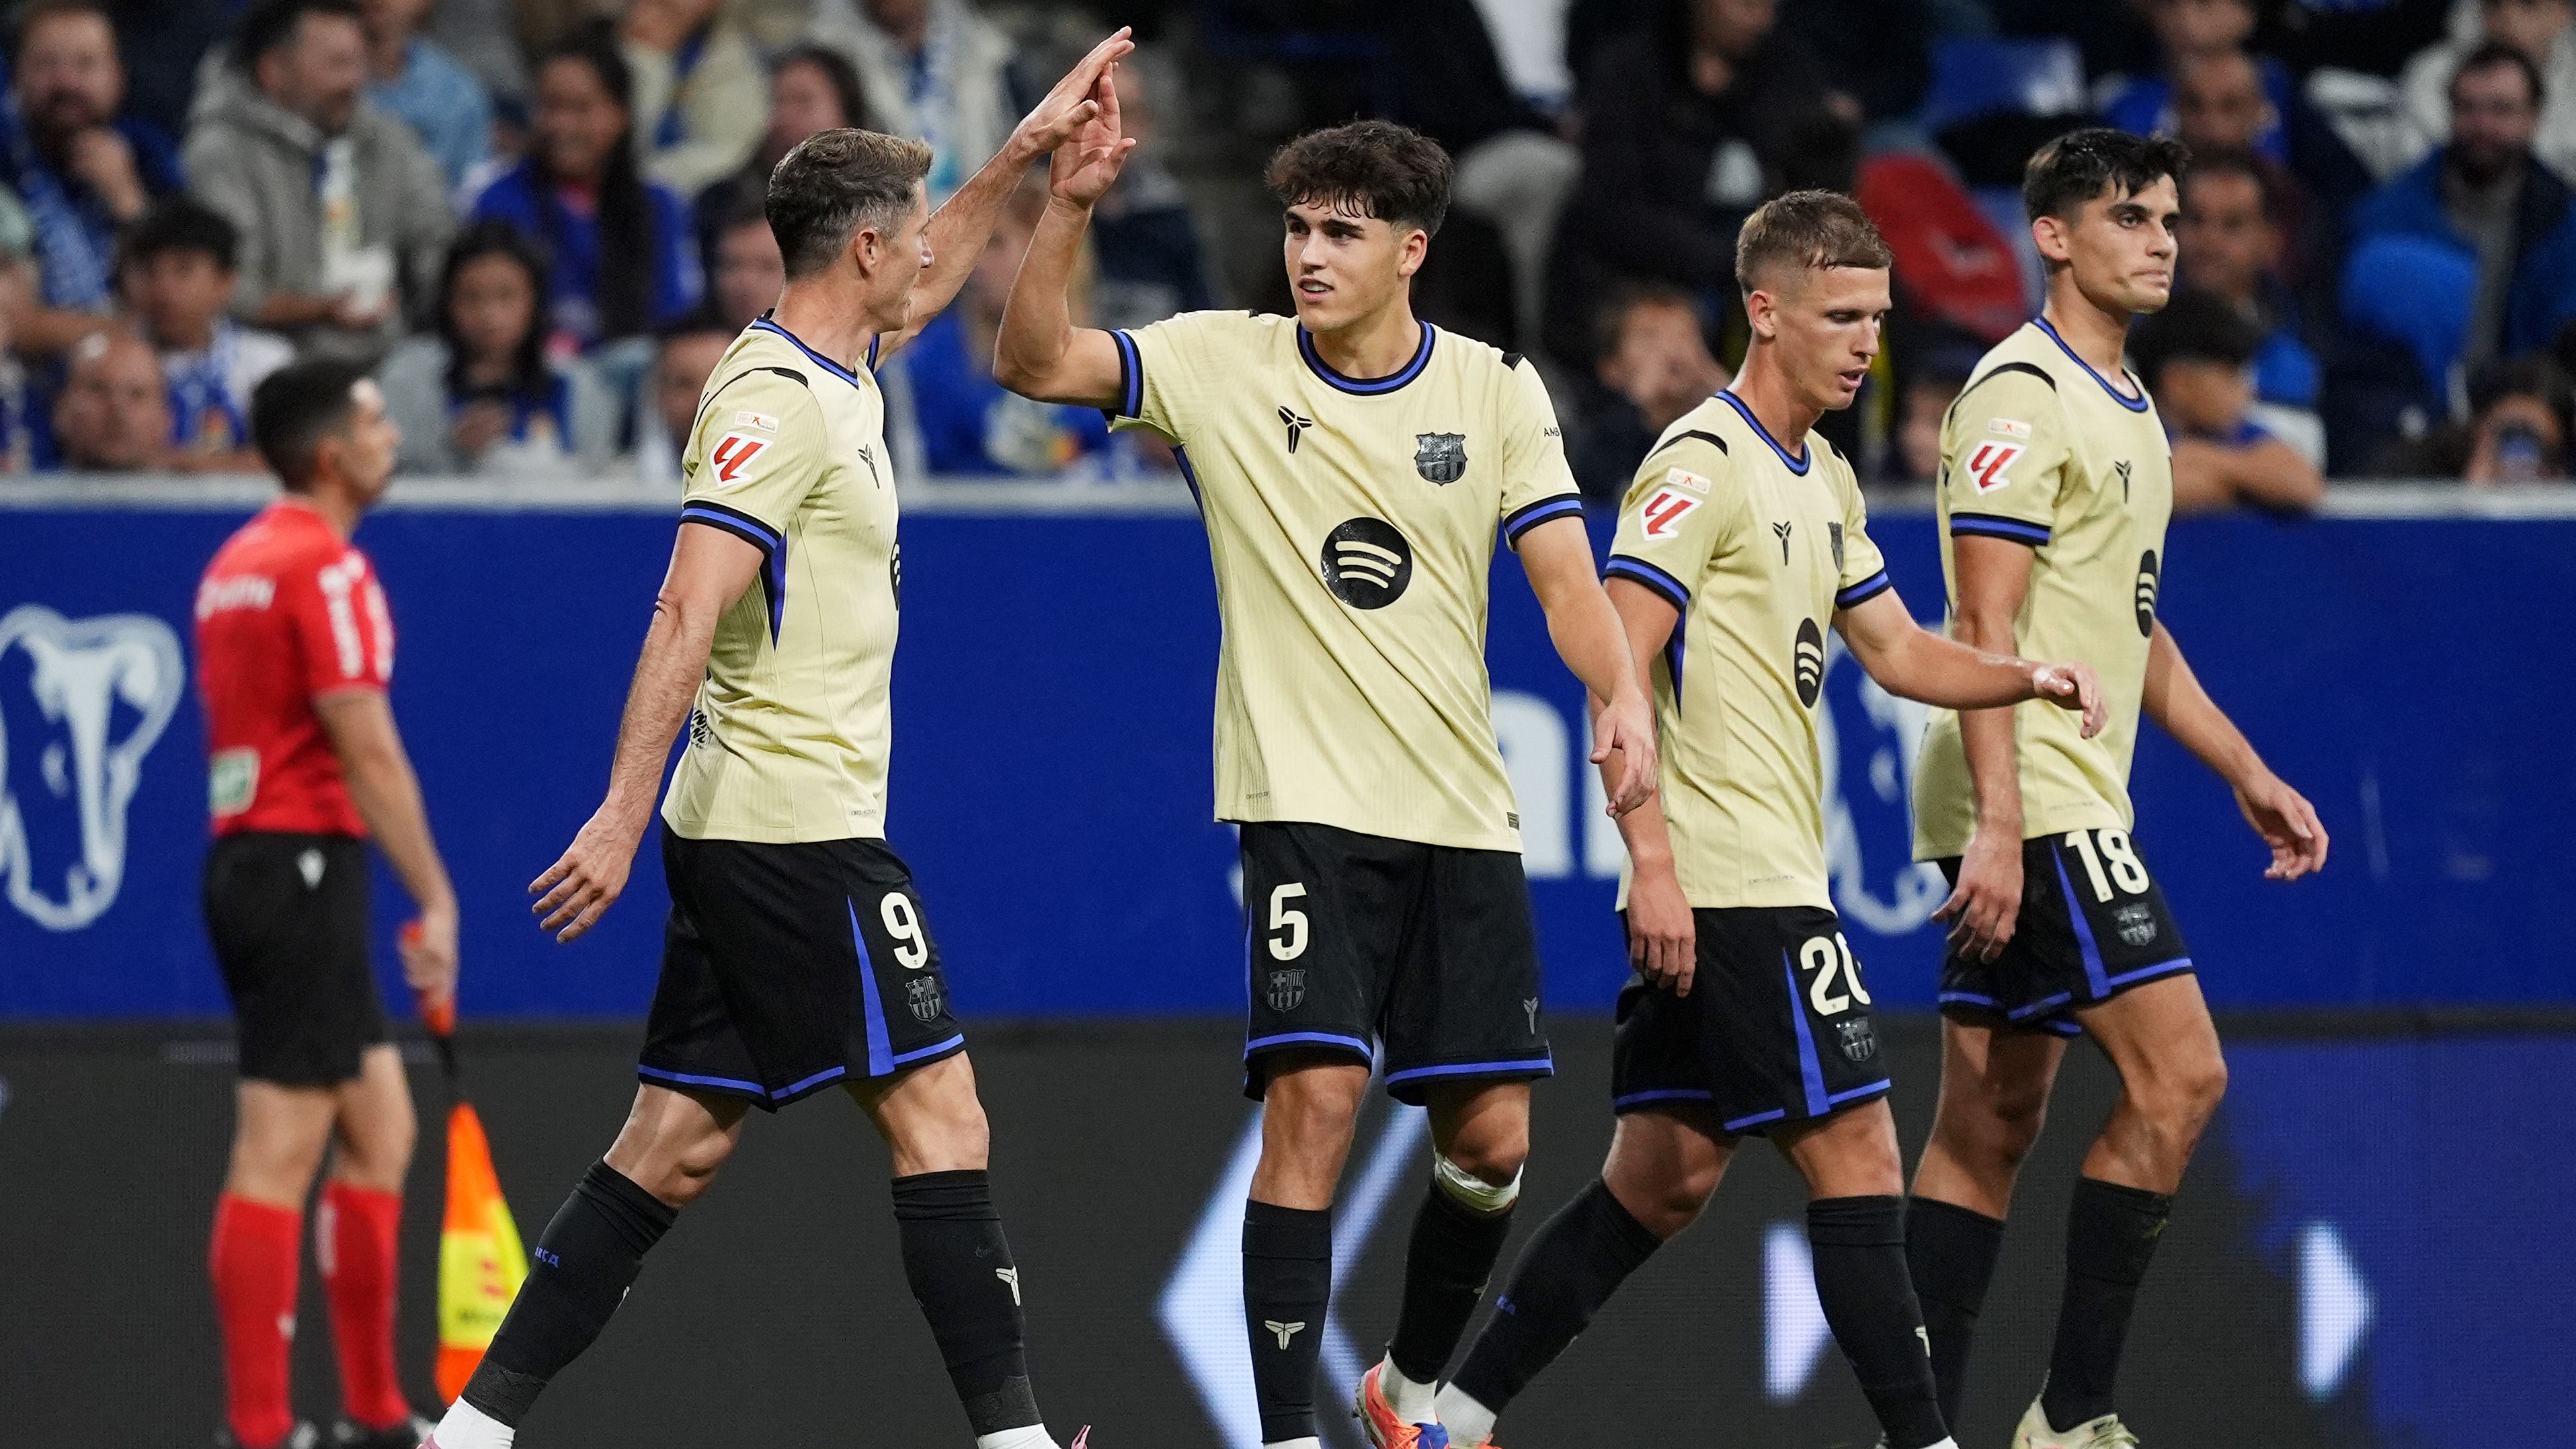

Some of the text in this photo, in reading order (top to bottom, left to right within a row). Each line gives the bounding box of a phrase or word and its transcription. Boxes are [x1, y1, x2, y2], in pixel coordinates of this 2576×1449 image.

[2064, 829, 2150, 903] 18
[880, 892, 928, 969] 9
[1269, 882, 1309, 961] 5
